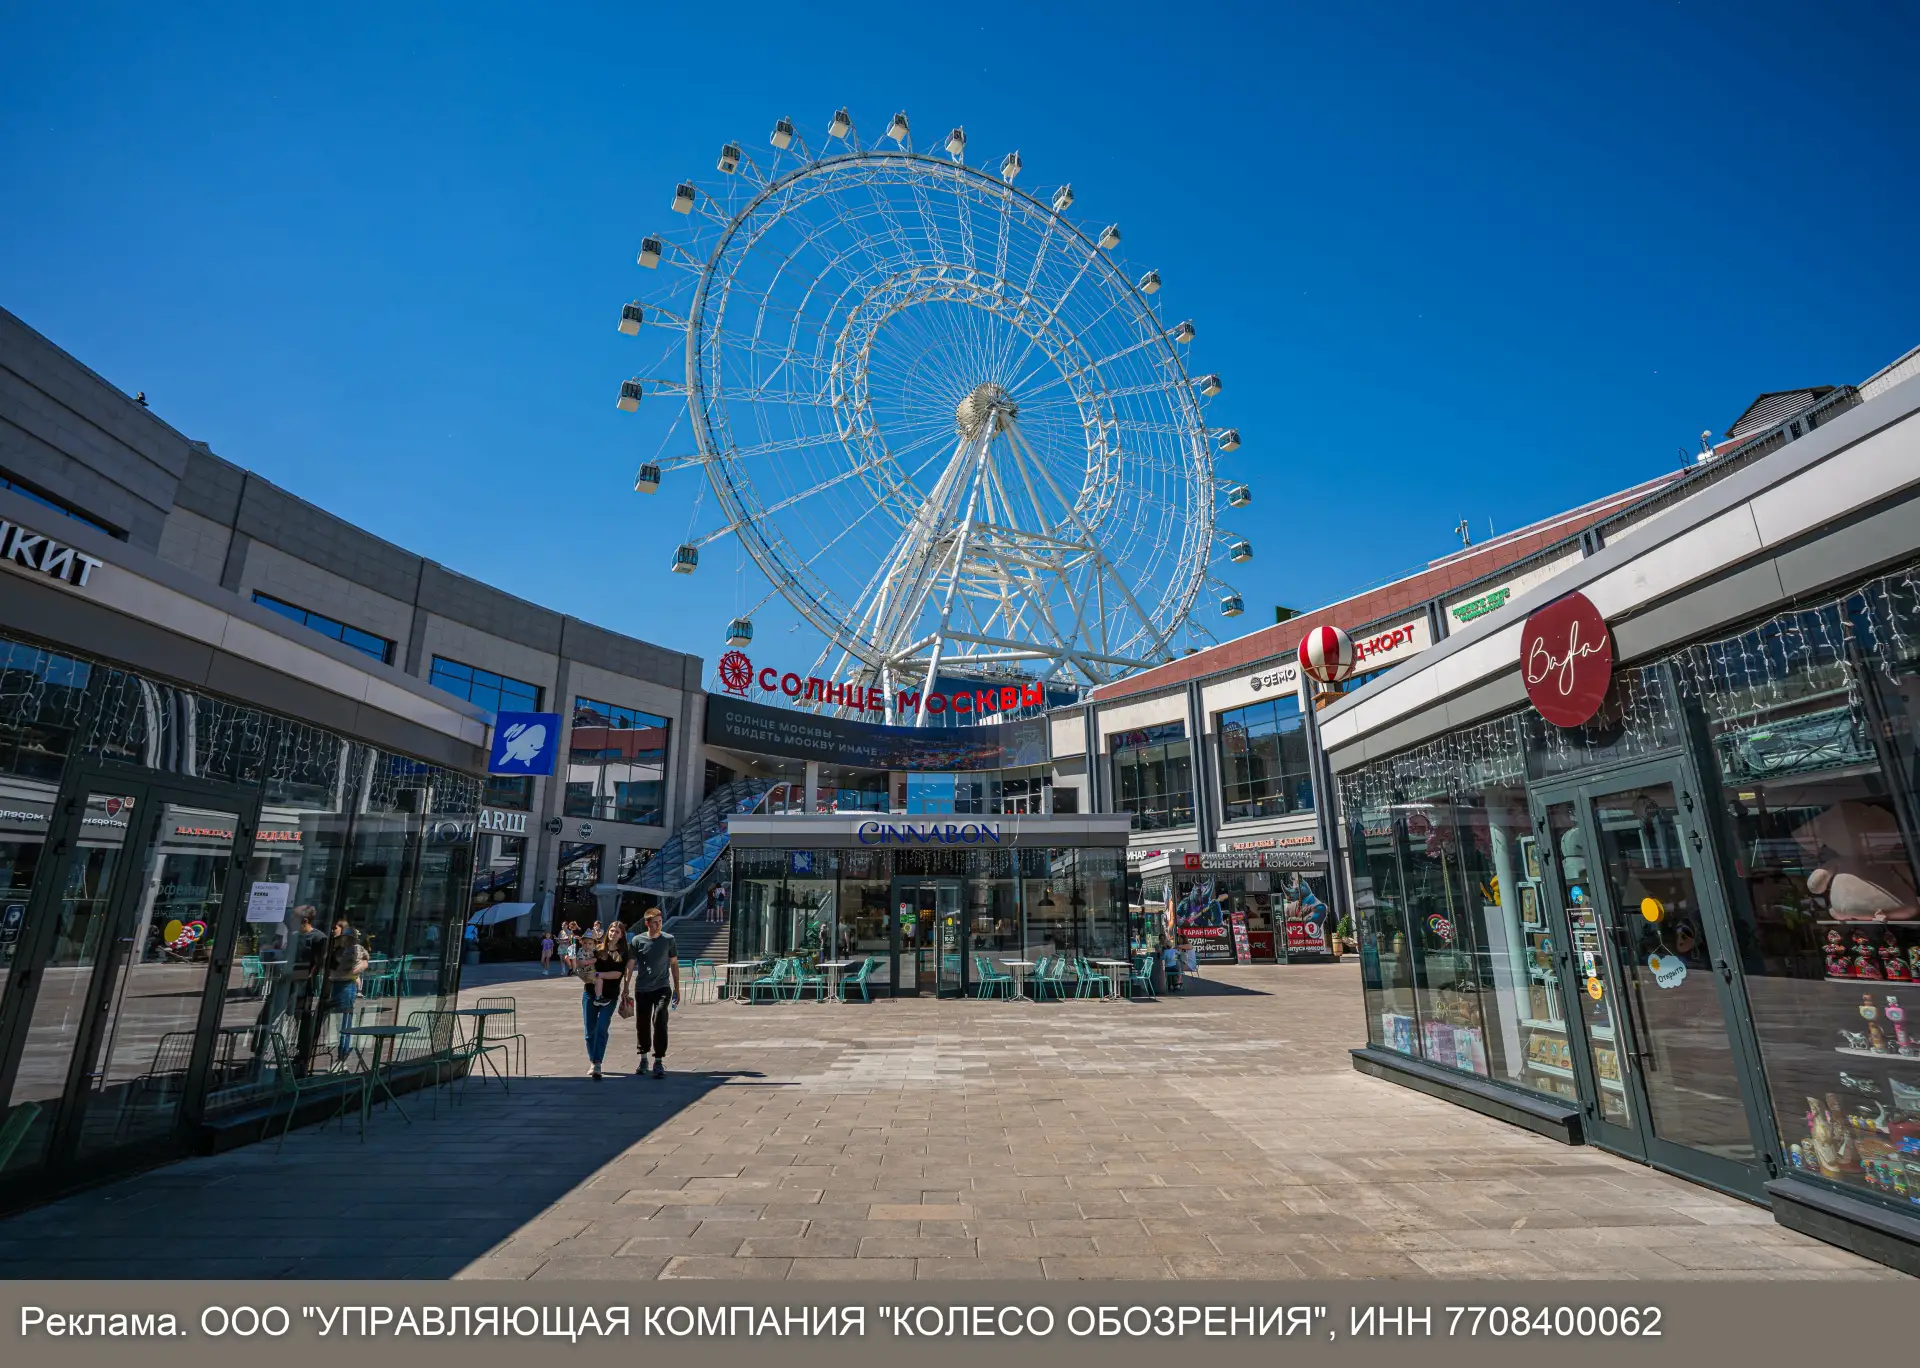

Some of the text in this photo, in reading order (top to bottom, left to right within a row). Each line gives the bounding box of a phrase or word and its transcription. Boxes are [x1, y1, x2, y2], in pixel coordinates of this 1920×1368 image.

[1355, 625, 1414, 661] Д-КОРТ
[1262, 667, 1296, 687] GEMO
[758, 668, 1043, 714] СОЛНЦЕ МОСКВЫ
[725, 712, 776, 730] СОЛНЦЕ
[779, 723, 832, 739] МОСКВЫ
[725, 724, 878, 756] УВИДЕТЬ МОСКВУ ИНАЧЕ
[858, 820, 1000, 846] CINNABON
[1126, 850, 1147, 860] ИНАР
[1203, 860, 1315, 869] СИНЕРГИЯ КОМИССИЯ
[1183, 928, 1217, 936] ГАРАНТИЯ
[1657, 966, 1684, 983] Открыто
